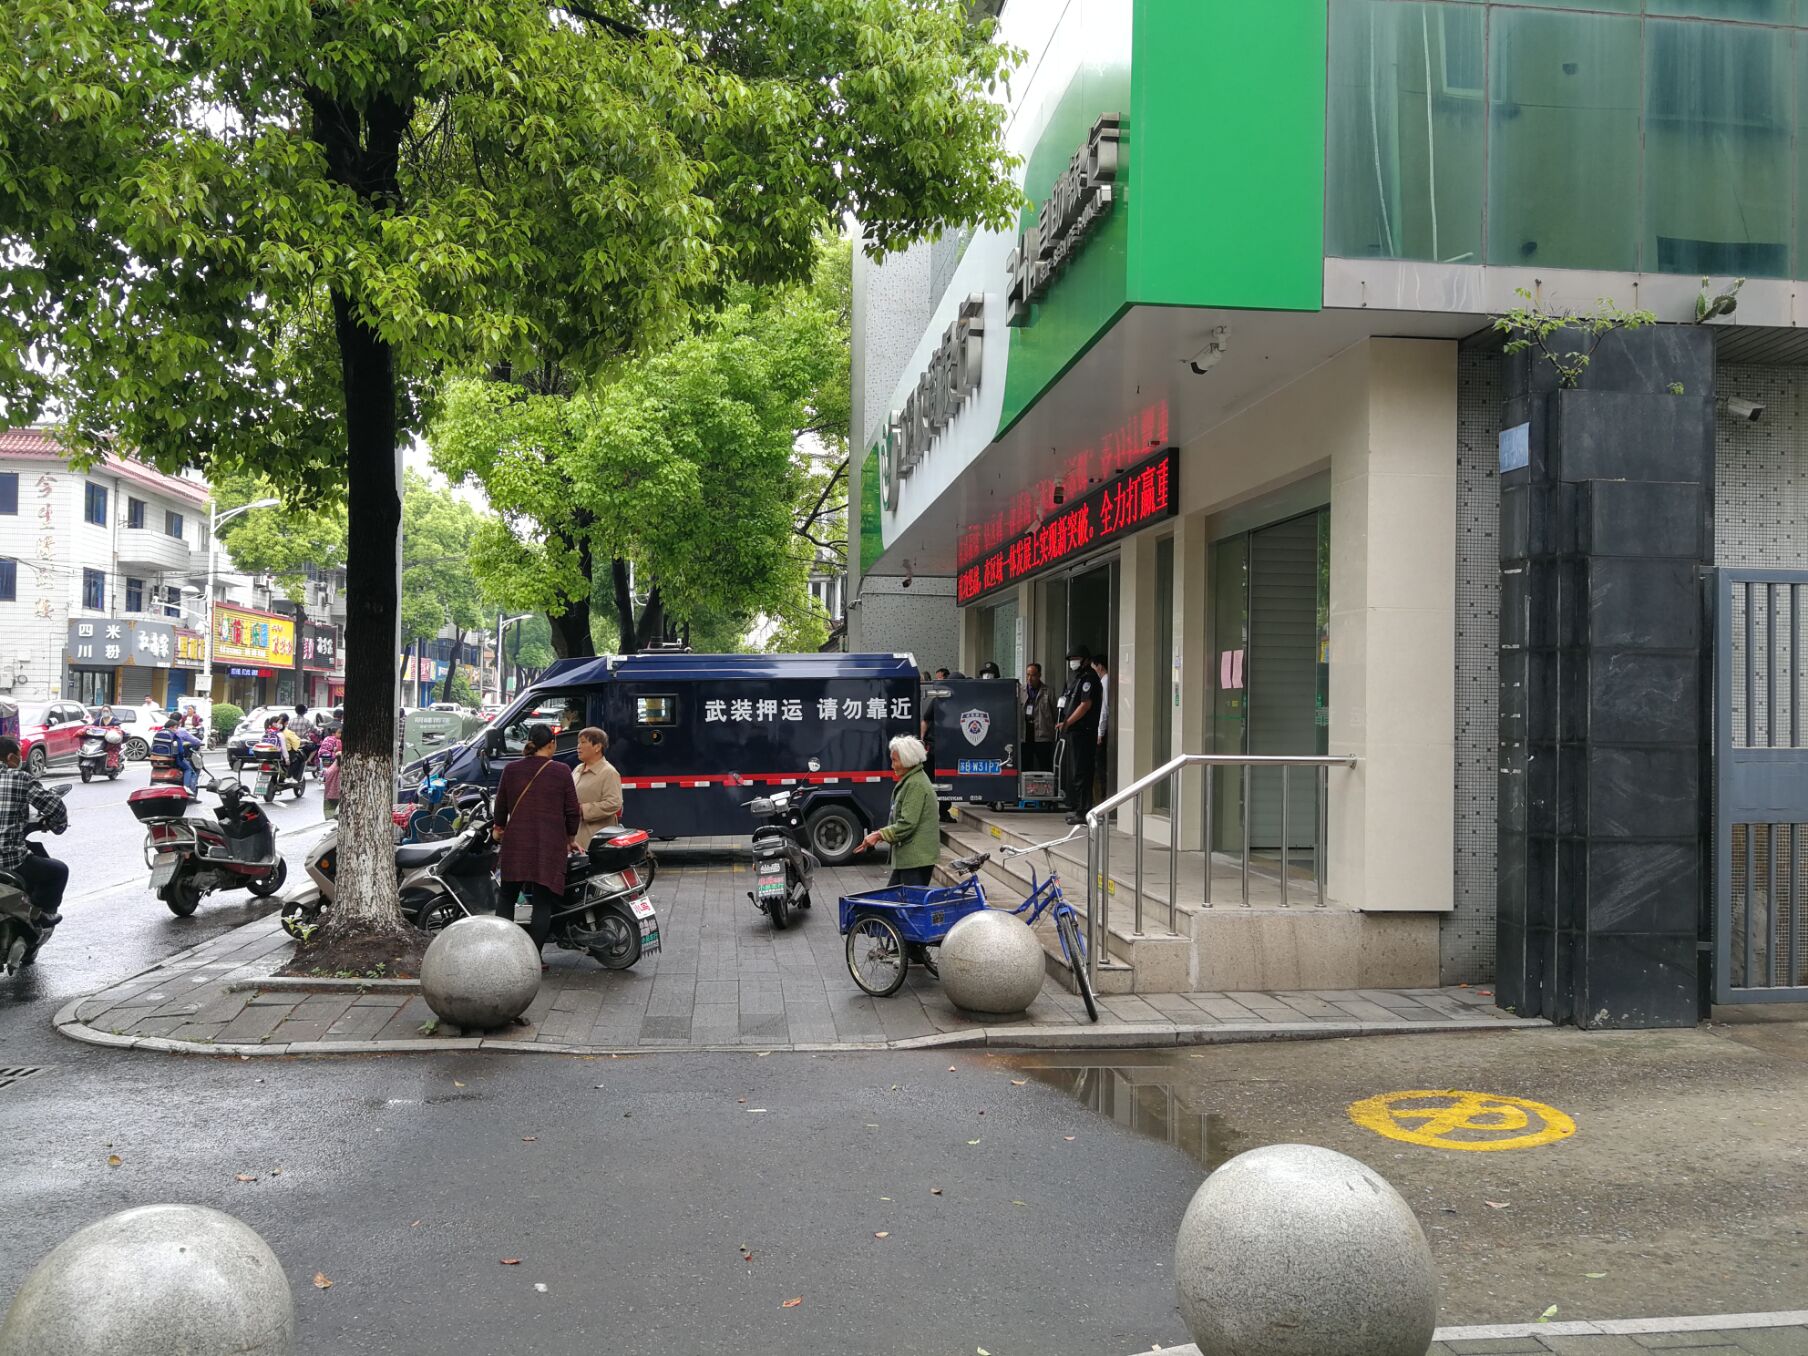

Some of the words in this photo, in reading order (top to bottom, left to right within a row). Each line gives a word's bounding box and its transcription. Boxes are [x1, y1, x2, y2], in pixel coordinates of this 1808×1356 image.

[704, 699, 803, 723] 武装押运
[816, 697, 912, 721] 请勿靠近
